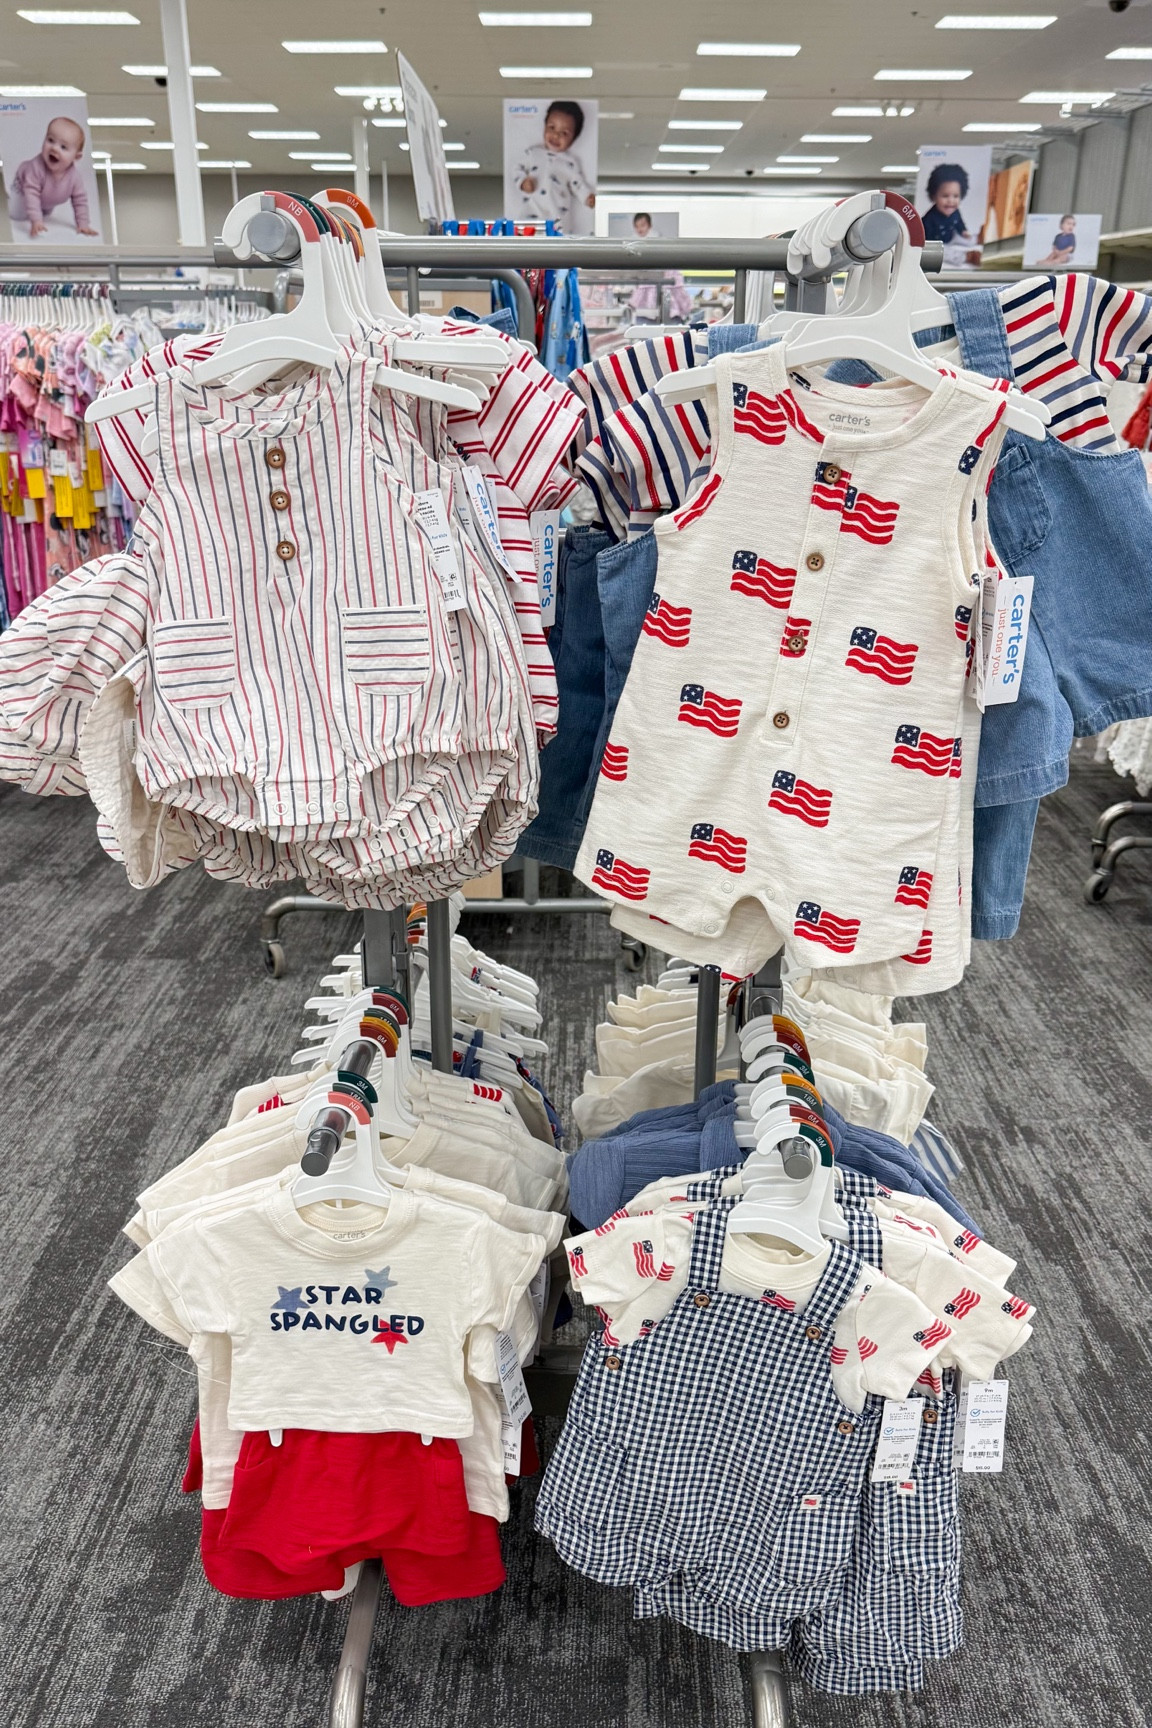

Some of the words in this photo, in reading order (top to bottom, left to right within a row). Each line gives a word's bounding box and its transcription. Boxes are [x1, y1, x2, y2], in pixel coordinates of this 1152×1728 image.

[288, 201, 303, 216] NB
[902, 205, 916, 221] 6M
[829, 413, 871, 427] carter's
[476, 483, 509, 567] carter's
[532, 537, 540, 556] just
[541, 524, 555, 608] carter's
[997, 608, 1008, 628] just
[994, 632, 1004, 653] one
[1002, 594, 1025, 684] carter's
[991, 655, 1002, 676] you
[376, 1034, 388, 1045] 6M
[792, 1042, 803, 1053] 6M
[799, 1065, 810, 1076] 3M
[356, 1080, 369, 1091] 3M
[348, 1101, 360, 1111] NB
[803, 1093, 817, 1107] 18M
[807, 1114, 819, 1124] 6M
[815, 1136, 827, 1148] 3M
[333, 1231, 366, 1240] carter's
[305, 1285, 383, 1305] STAR
[270, 1311, 425, 1336] SPANGLED
